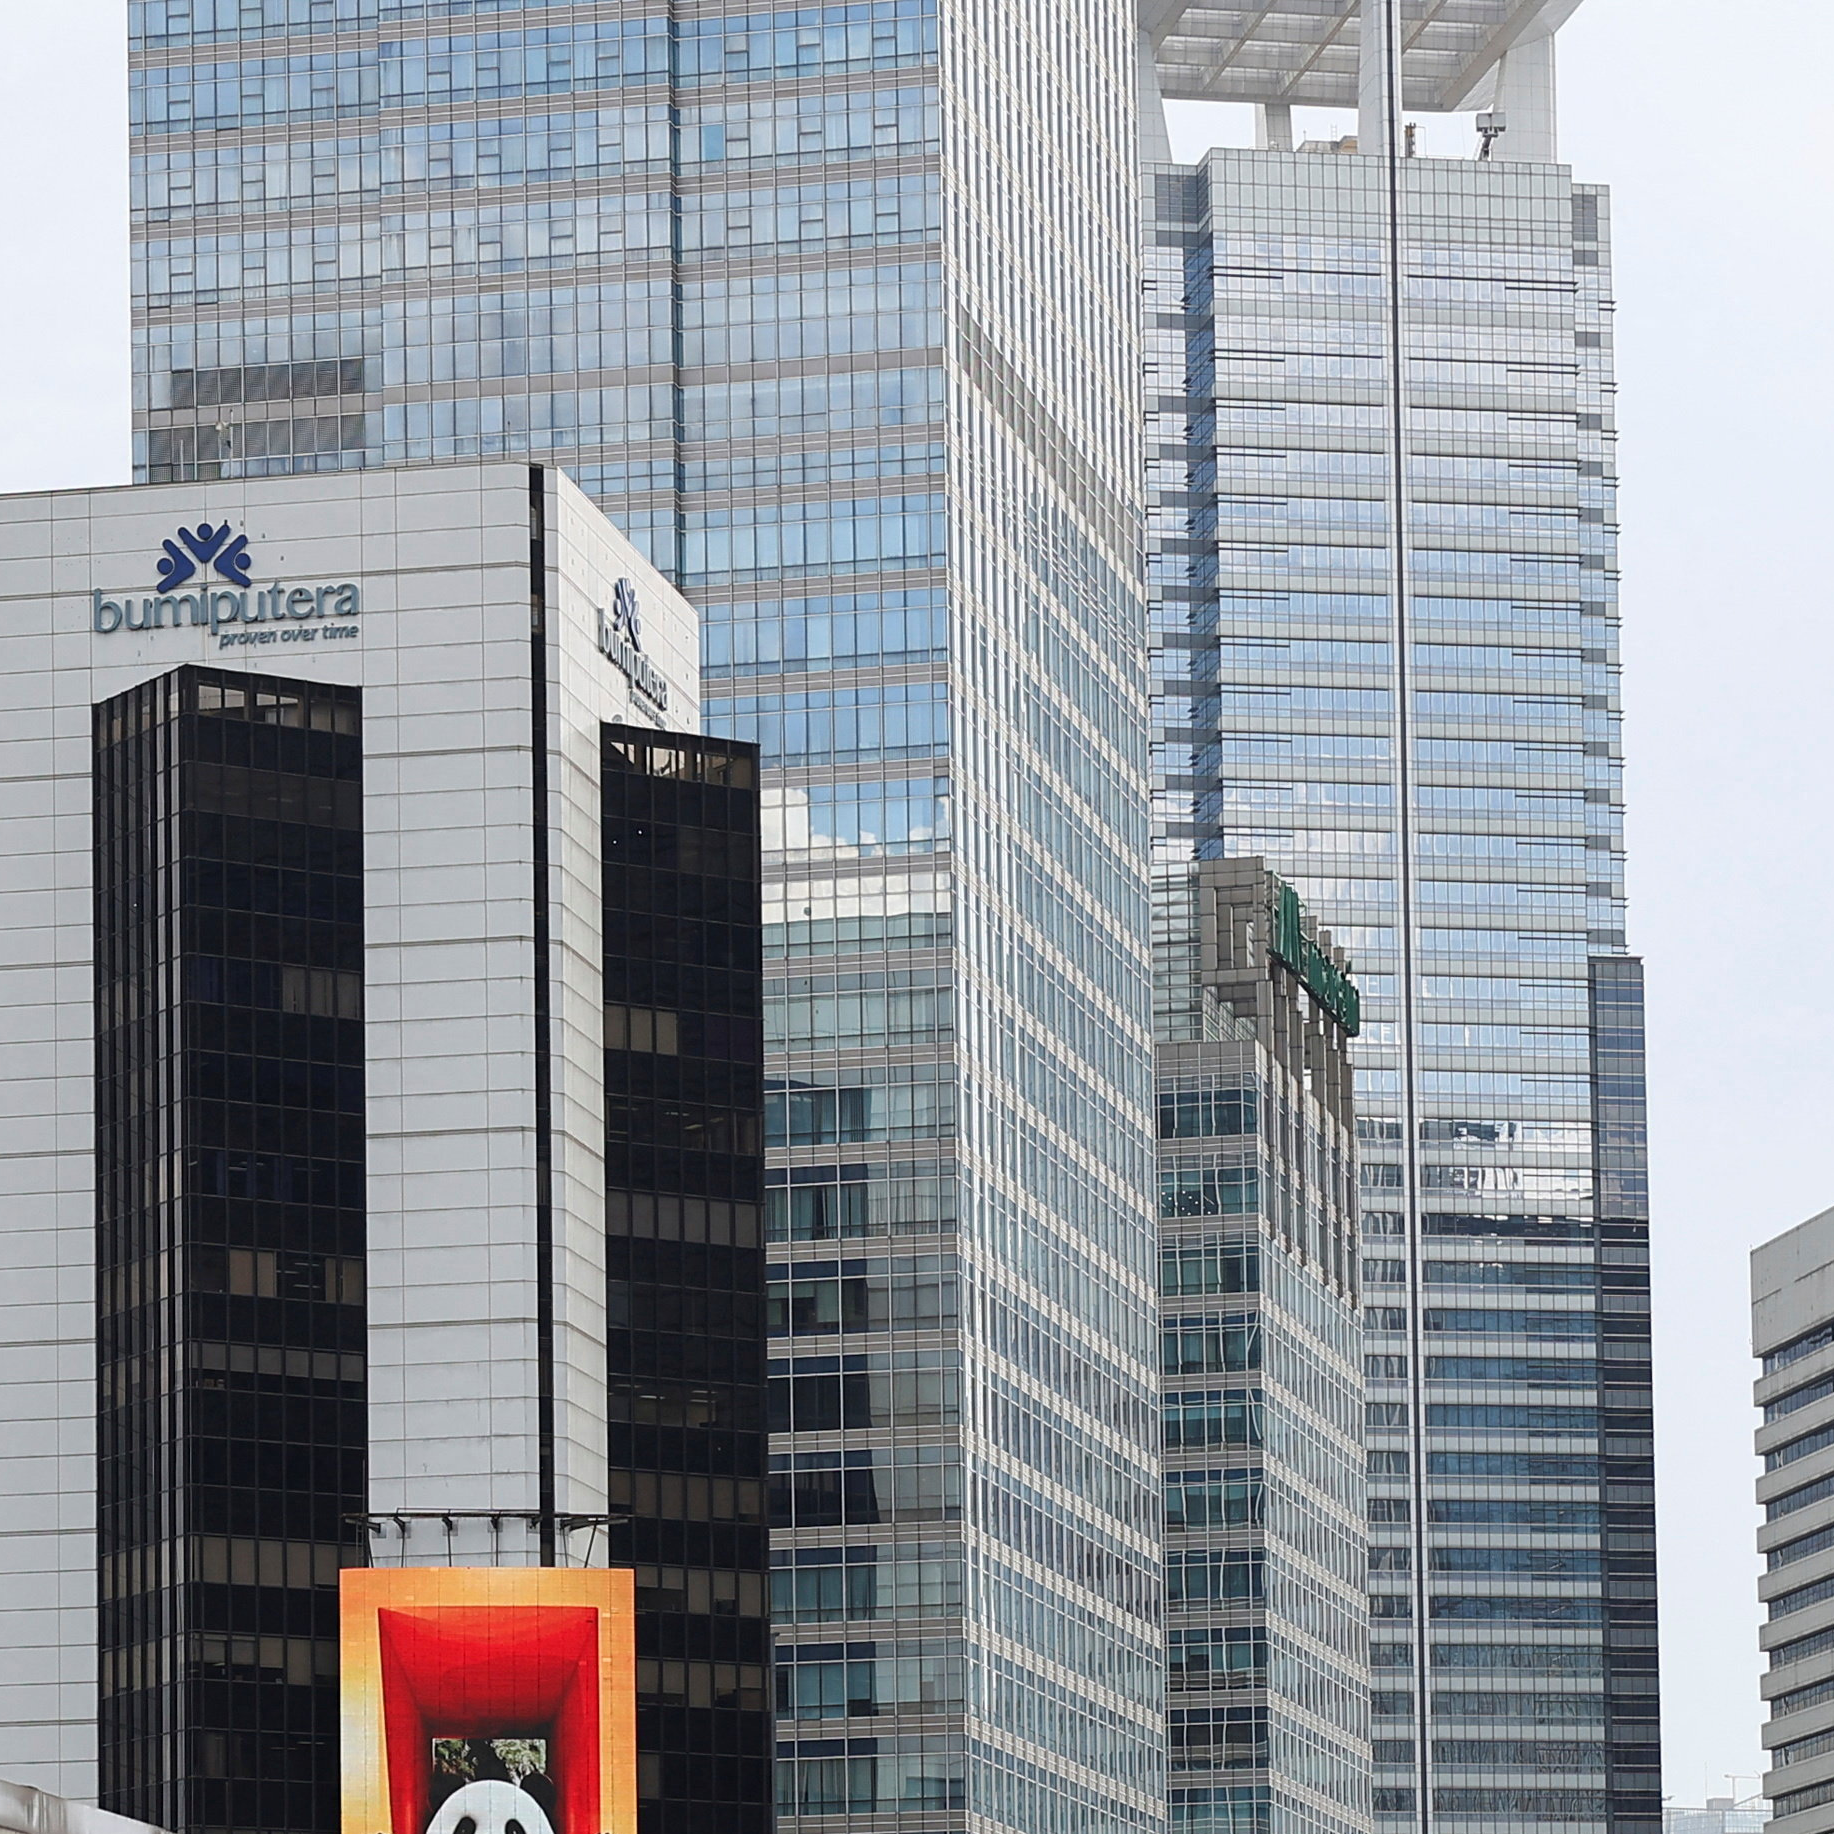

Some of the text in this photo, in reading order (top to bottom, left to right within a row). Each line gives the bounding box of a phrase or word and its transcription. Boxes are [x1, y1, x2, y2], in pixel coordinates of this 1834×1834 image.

[92, 581, 360, 634] bumiputera
[218, 621, 359, 650] proven over time
[598, 608, 667, 711] bumiputera
